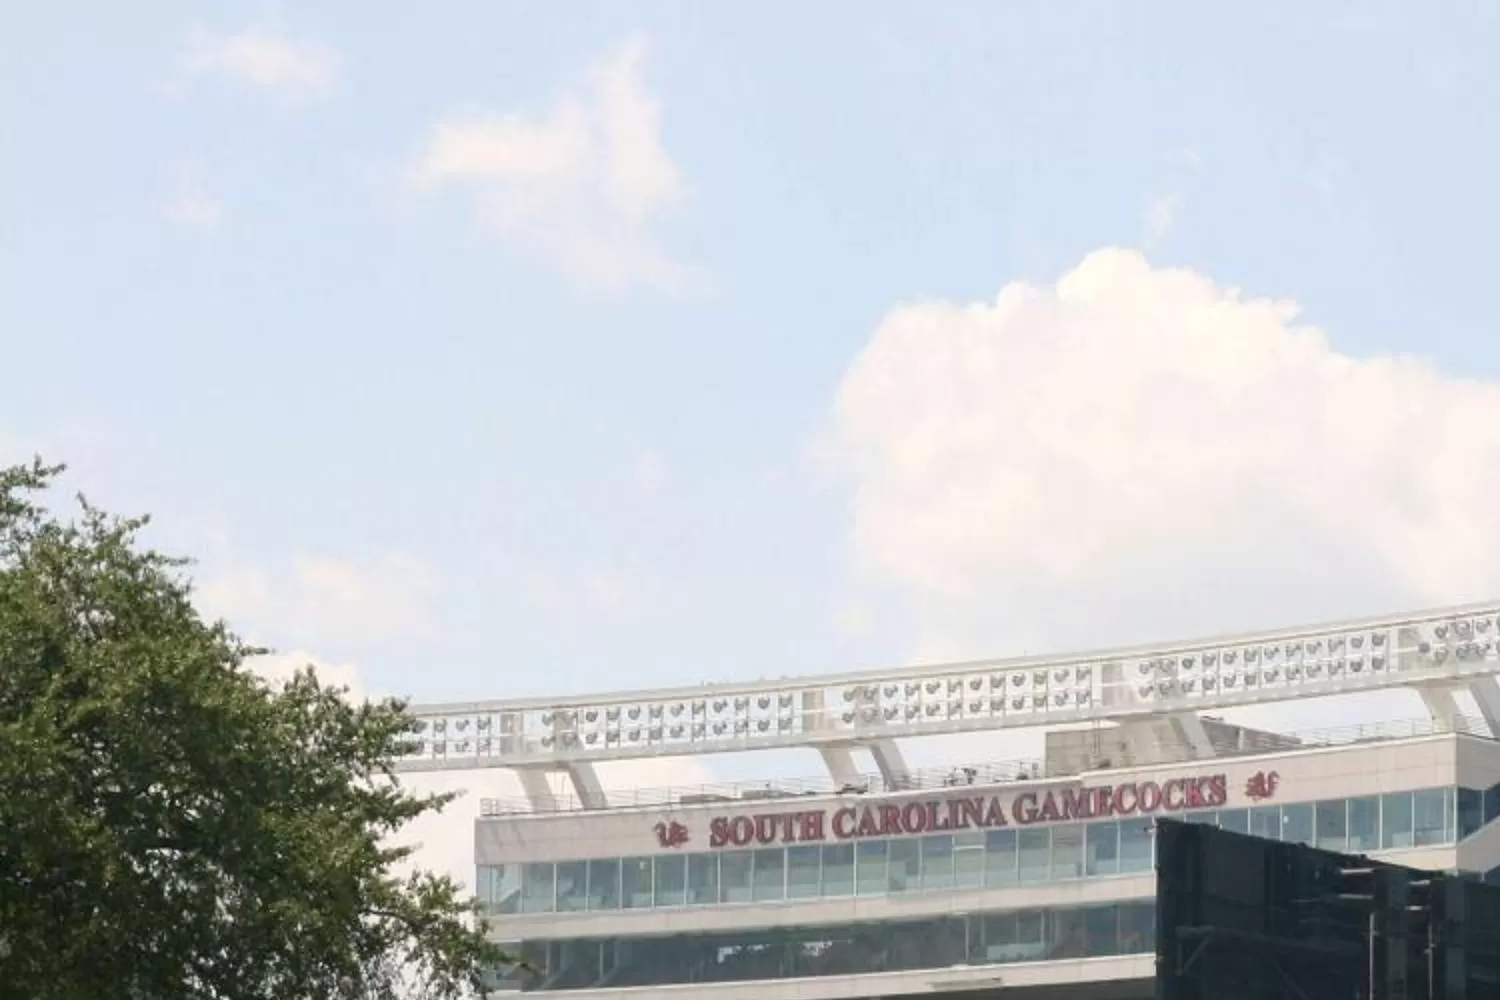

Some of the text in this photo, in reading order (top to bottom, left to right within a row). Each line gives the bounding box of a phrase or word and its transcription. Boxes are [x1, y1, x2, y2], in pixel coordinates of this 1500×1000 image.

[709, 773, 1228, 848] SOUTH CAROLINA GAMECOCKS
